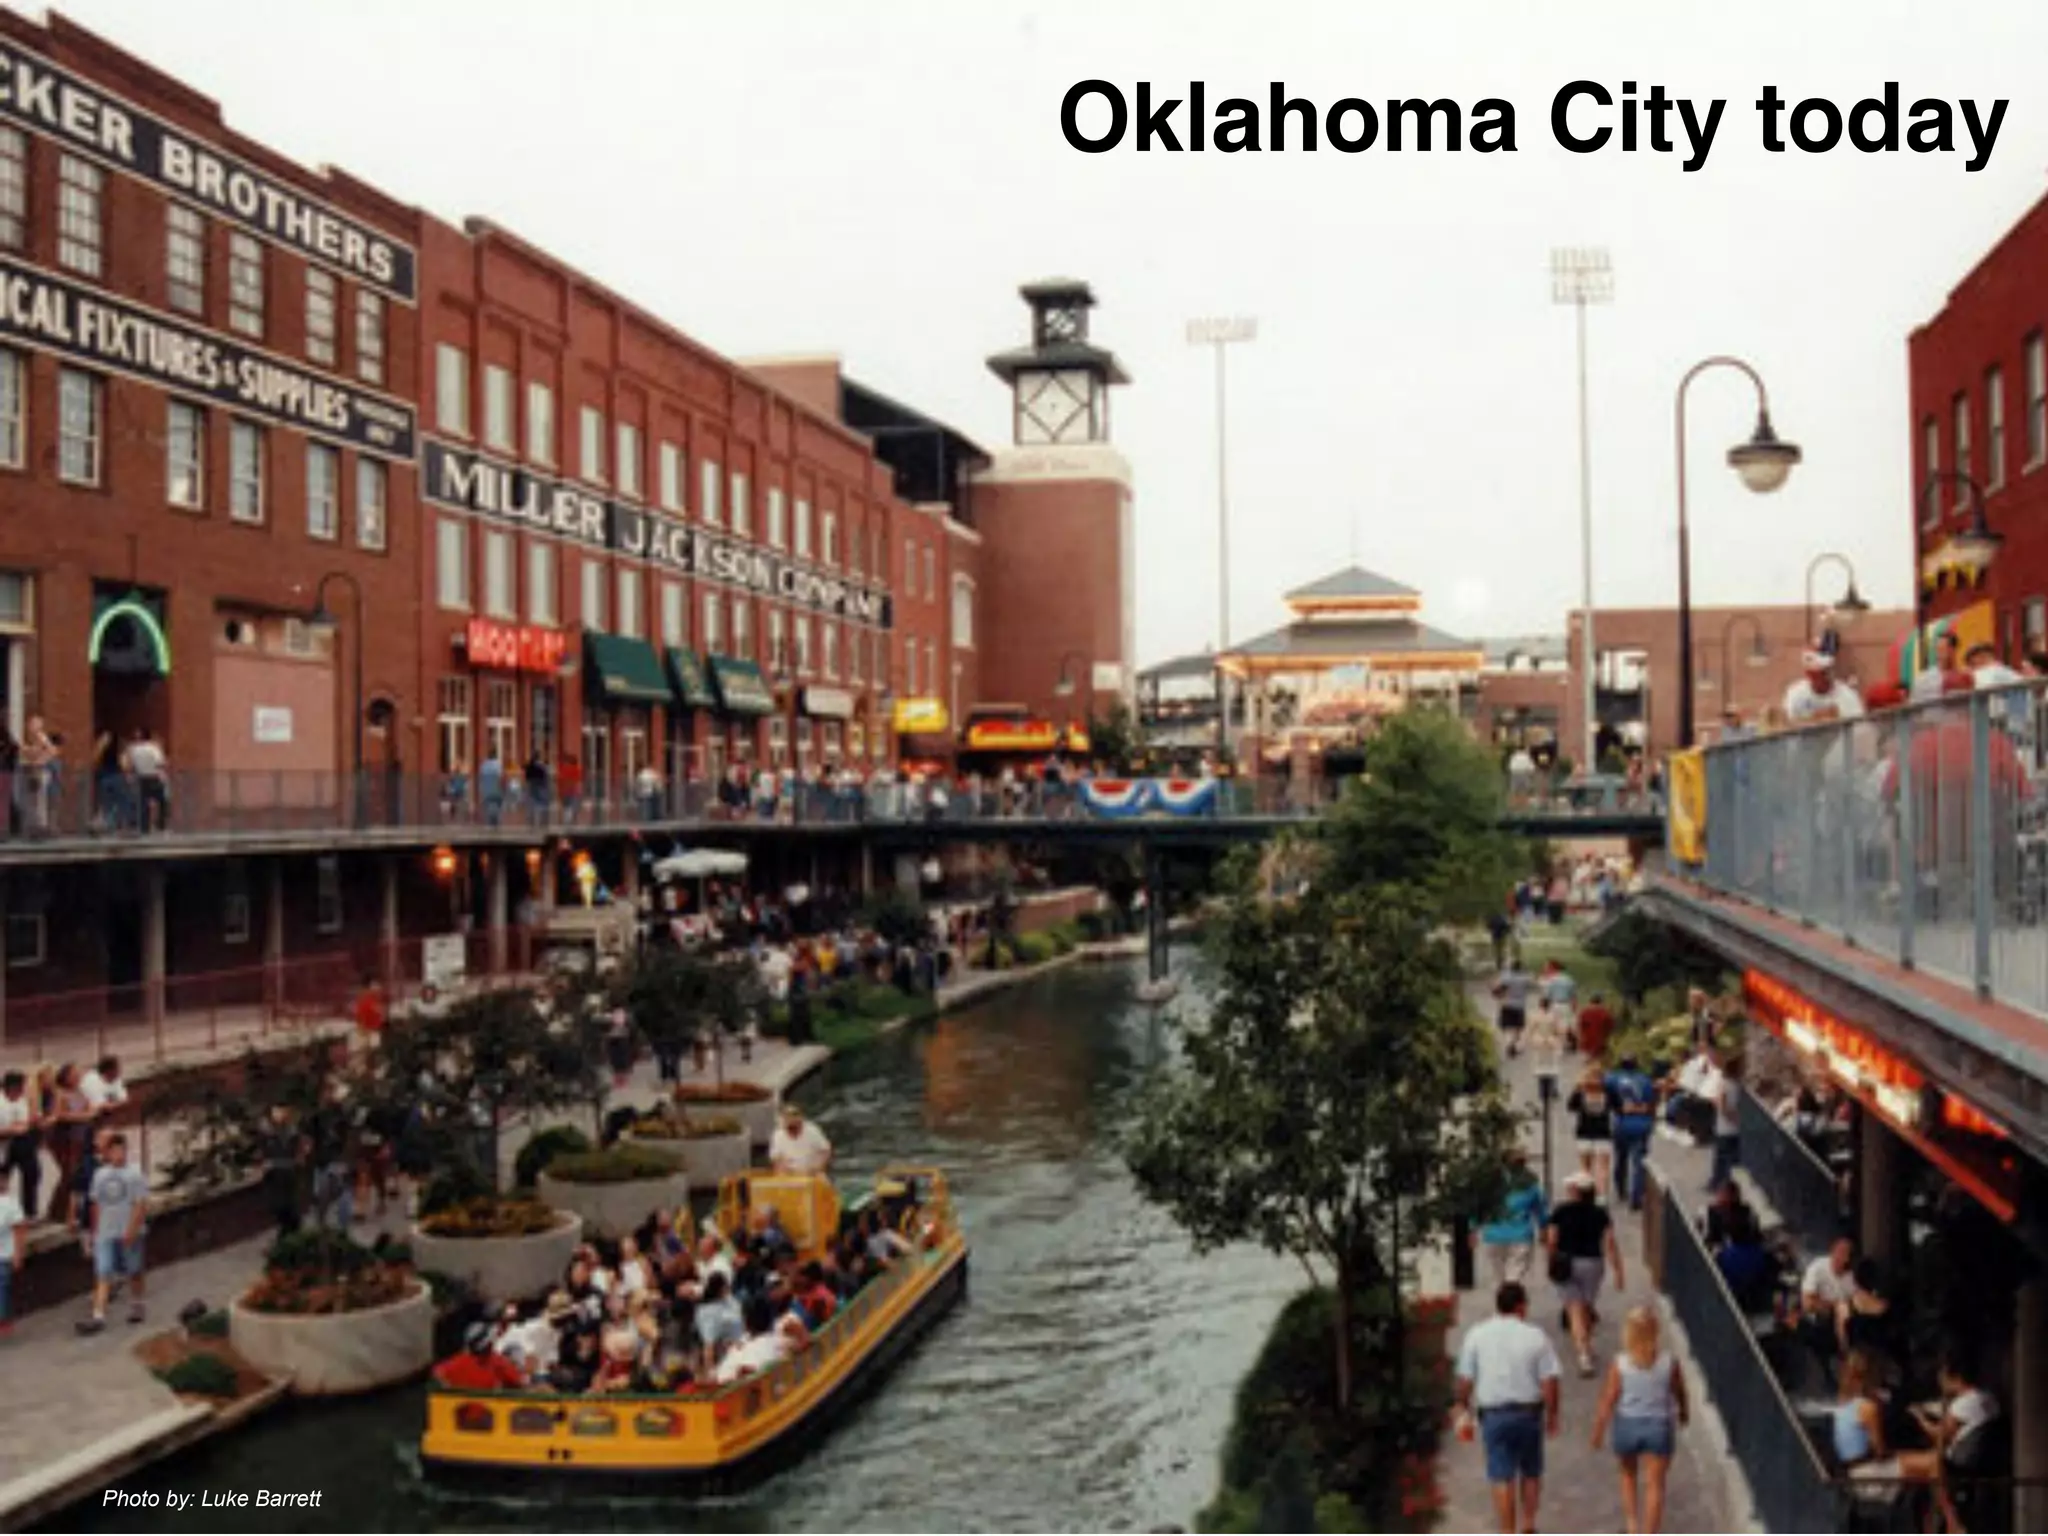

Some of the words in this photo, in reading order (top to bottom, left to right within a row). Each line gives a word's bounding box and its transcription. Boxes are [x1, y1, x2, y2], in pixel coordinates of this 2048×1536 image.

[160, 134, 394, 283] BROTHERS
[77, 299, 219, 389] FIXTURES
[238, 355, 349, 430] SUPPLIES
[441, 452, 605, 542] MILLER
[622, 512, 771, 588] JACKSON
